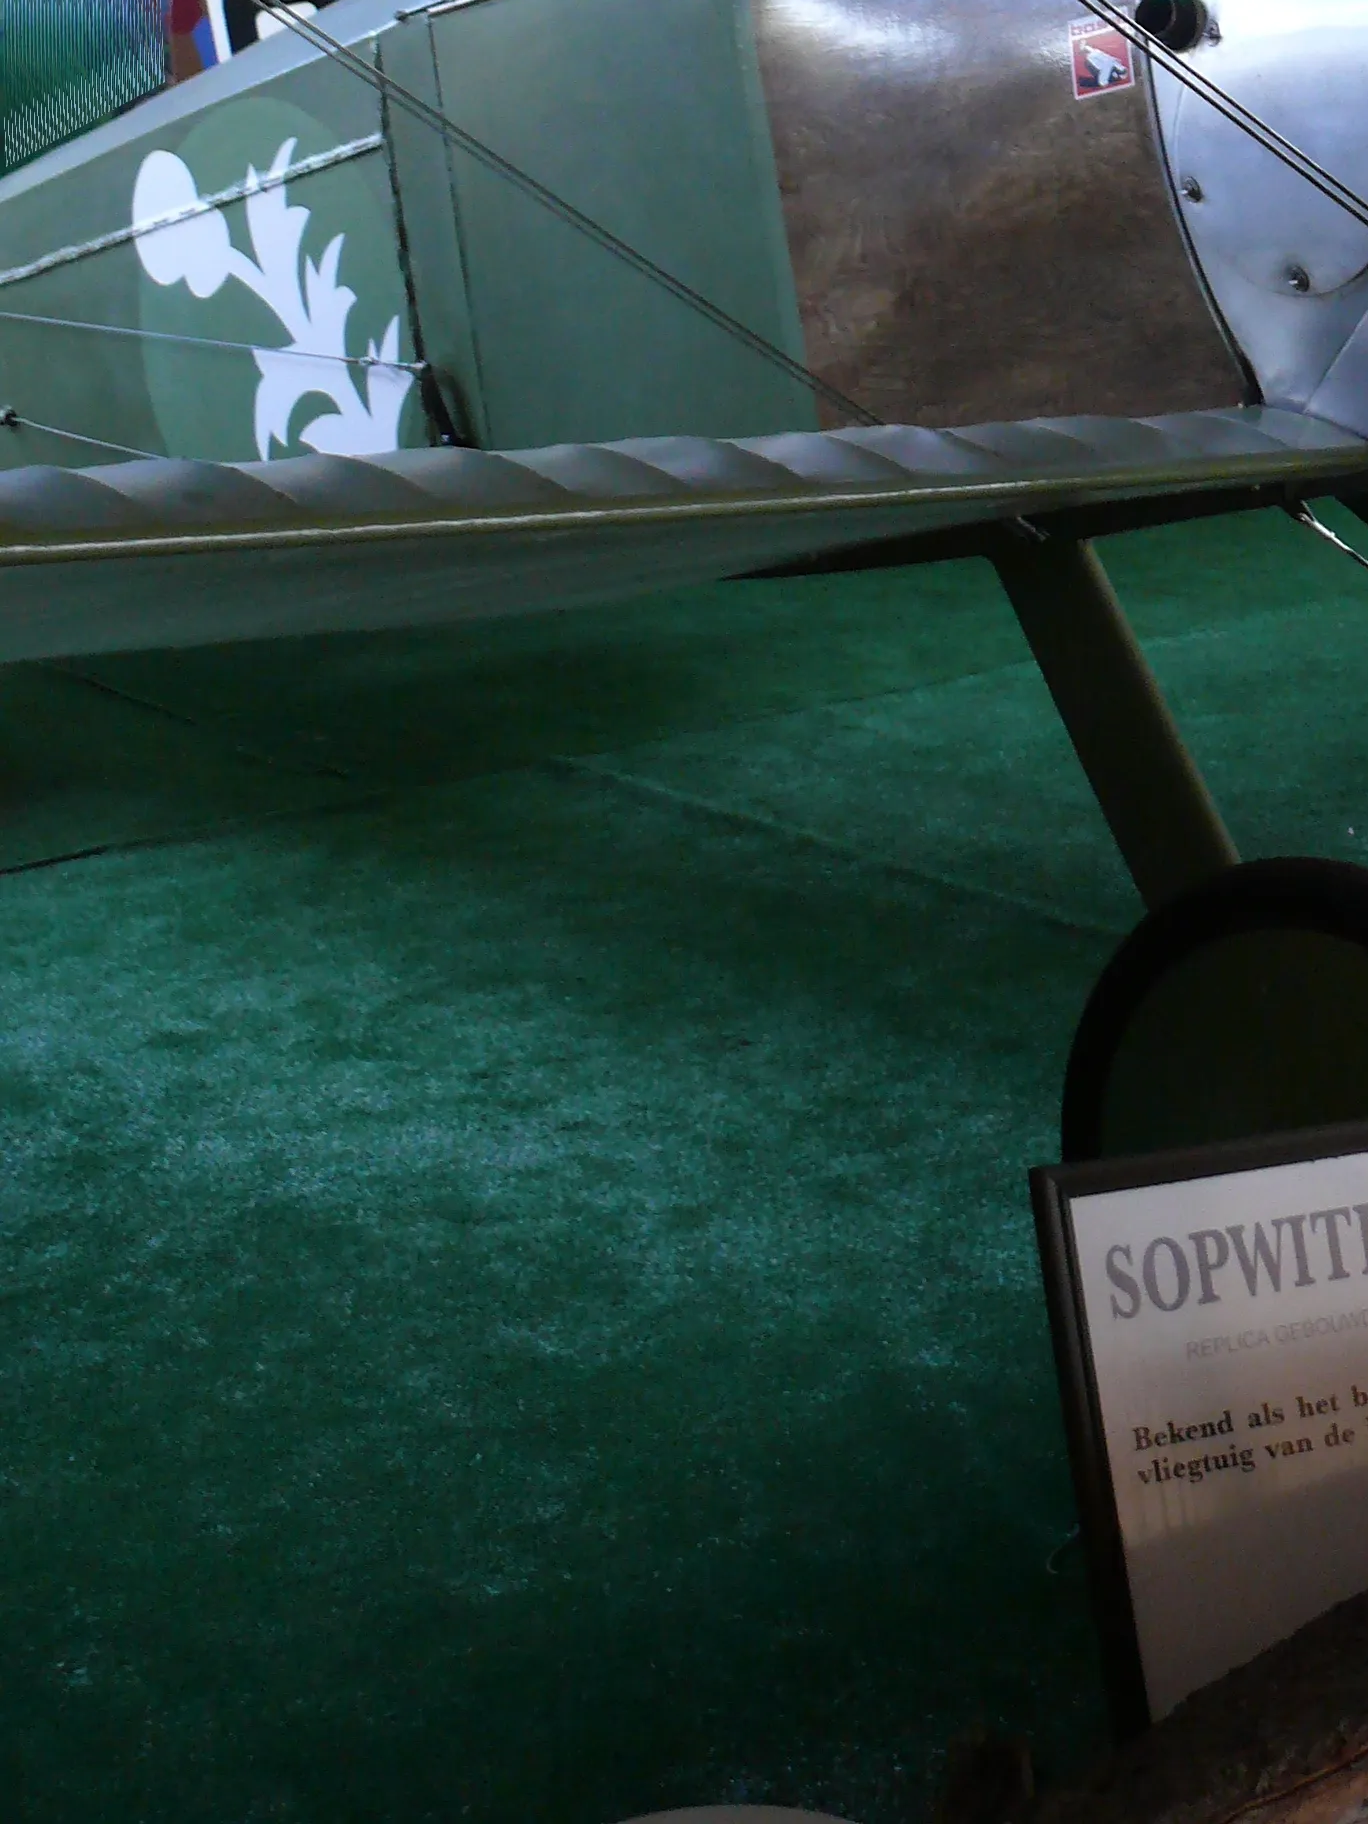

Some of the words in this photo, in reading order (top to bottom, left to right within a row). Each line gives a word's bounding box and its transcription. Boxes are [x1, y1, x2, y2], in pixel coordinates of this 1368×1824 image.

[1186, 1328, 1270, 1360] REPLICA
[1132, 1409, 1235, 1452] Bekend
[1248, 1402, 1285, 1429] als
[1295, 1393, 1340, 1418] het
[1137, 1443, 1256, 1484] vliegtuig
[1265, 1435, 1314, 1460] van
[1324, 1422, 1356, 1448] de
